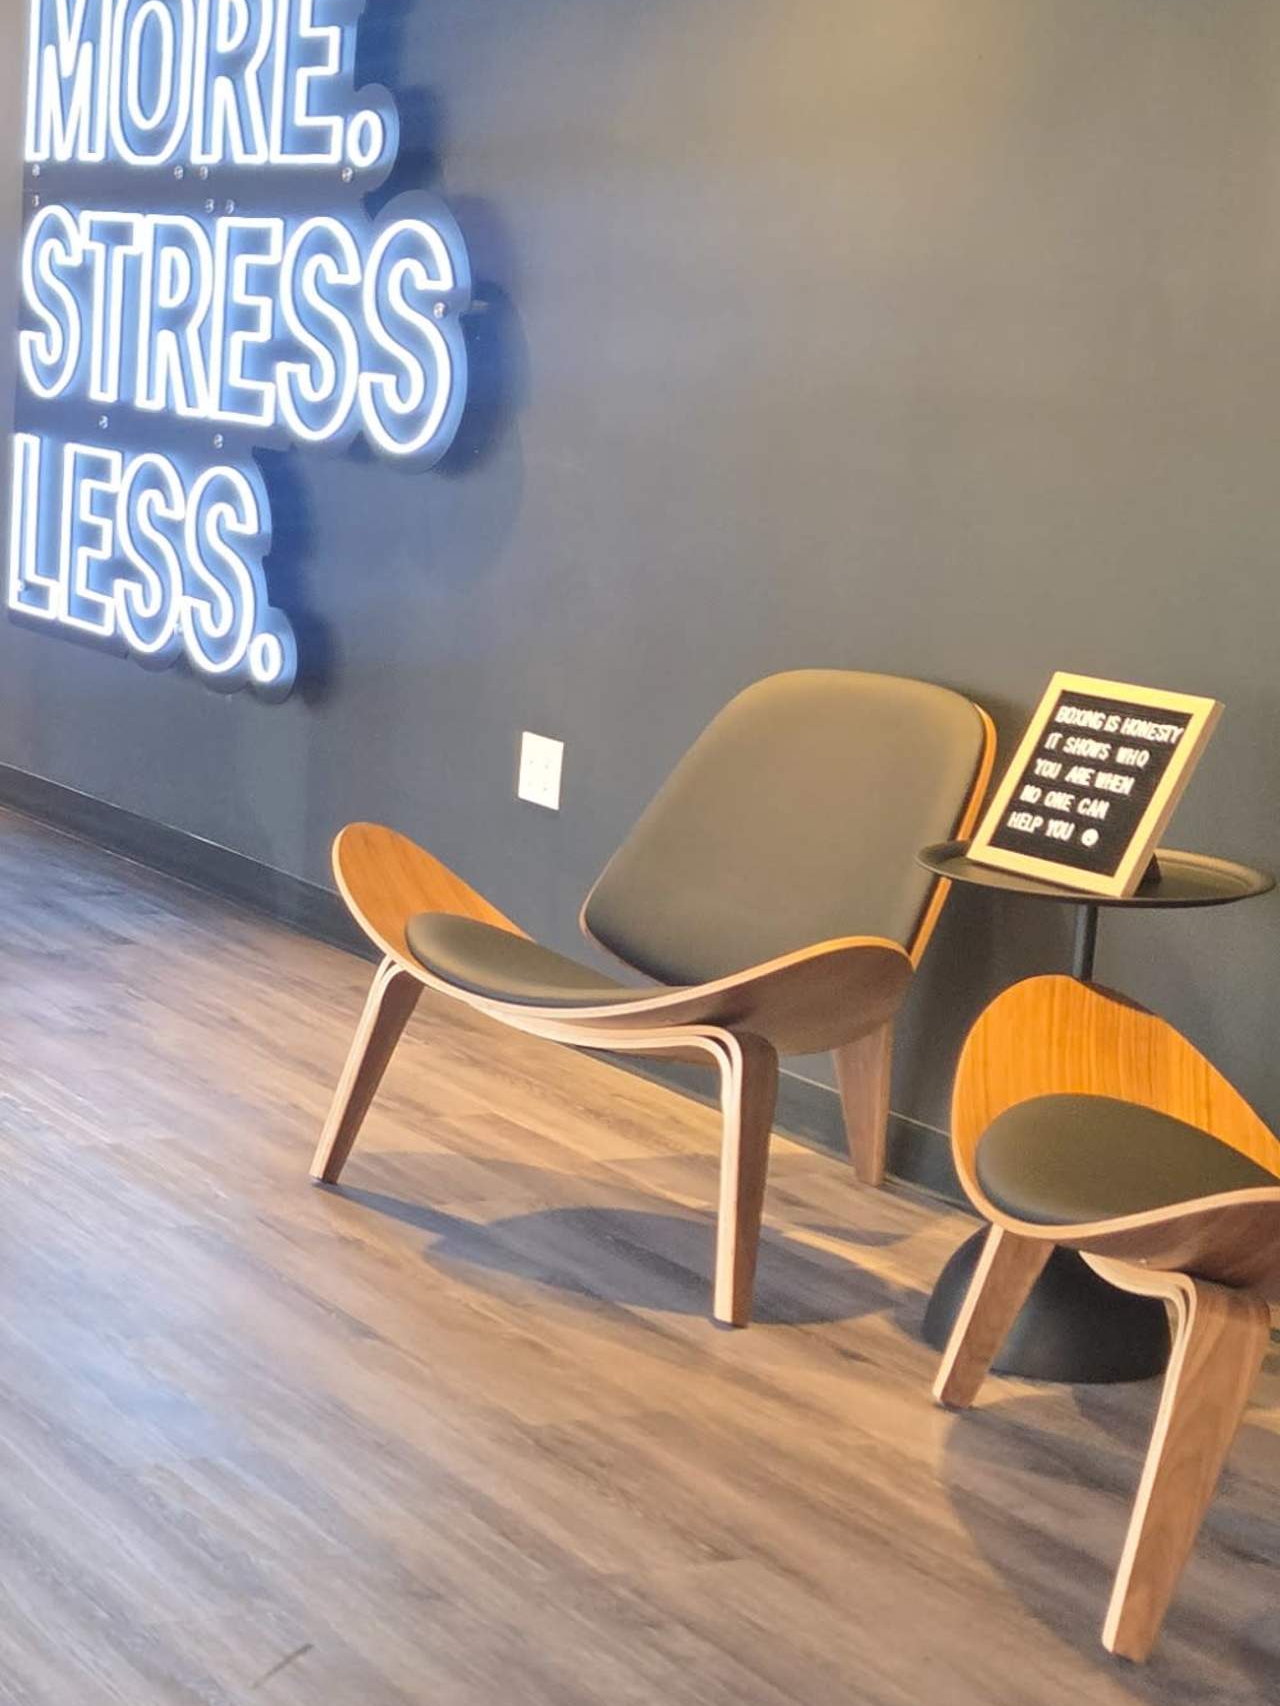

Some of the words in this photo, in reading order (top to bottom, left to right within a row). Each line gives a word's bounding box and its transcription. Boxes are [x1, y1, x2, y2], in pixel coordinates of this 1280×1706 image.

[19, 204, 455, 455] STRESS
[8, 431, 283, 682] LESS.
[1054, 705, 1107, 730] BOXING
[1103, 715, 1122, 733] IS
[1120, 717, 1185, 744] HONESTY
[1044, 732, 1063, 750] IT
[1062, 736, 1112, 761] SHOWS
[1115, 746, 1151, 768] WHO
[1034, 758, 1063, 780] YOU
[1064, 765, 1096, 786] ARE
[1094, 770, 1135, 795] WHEN
[1019, 784, 1042, 804] NO
[1043, 790, 1075, 813] ONE
[1076, 797, 1110, 820] CAN
[1006, 811, 1044, 834] HELP
[1044, 819, 1076, 841] YOU
